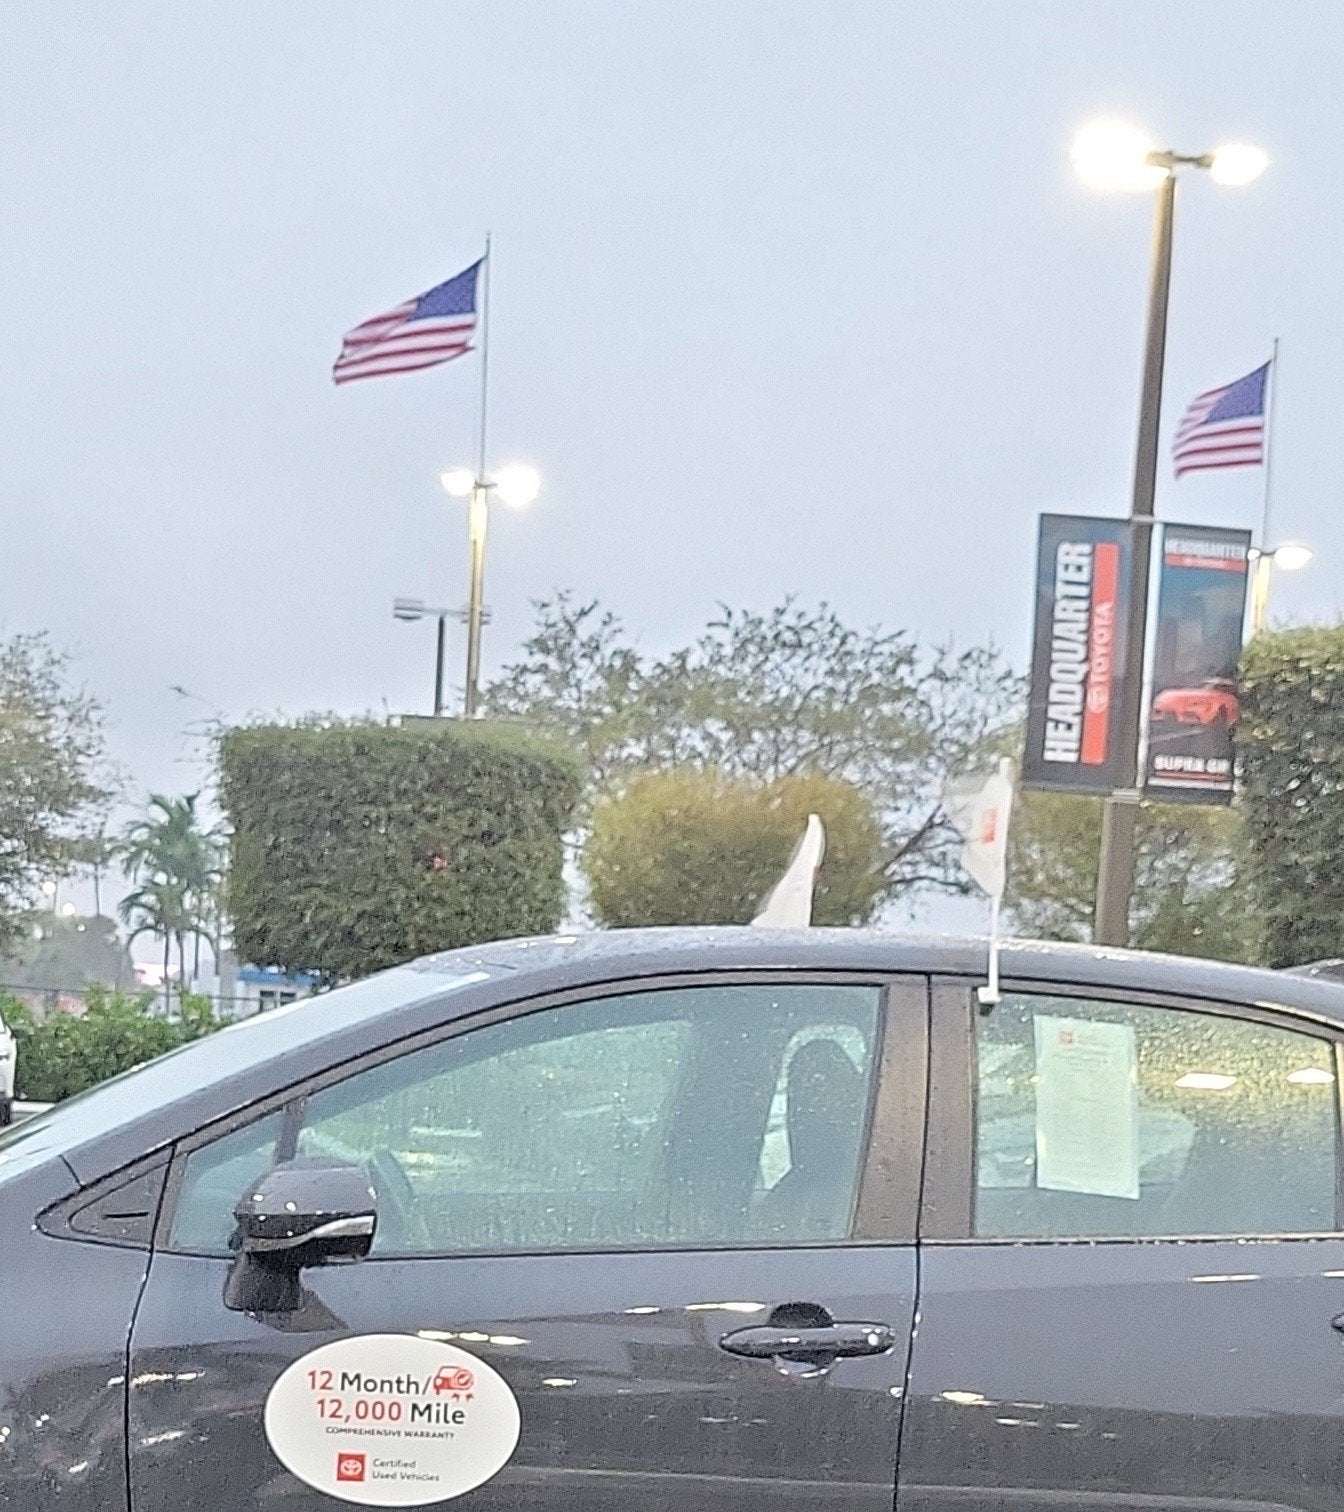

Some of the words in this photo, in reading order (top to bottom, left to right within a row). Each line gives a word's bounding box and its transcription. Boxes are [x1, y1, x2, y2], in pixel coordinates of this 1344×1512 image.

[1043, 542, 1091, 763] HEADQUARTER
[1091, 602, 1114, 683] TOYOTA
[308, 1370, 333, 1390] 12
[340, 1372, 432, 1395] Month/
[317, 1398, 401, 1423] 12,000
[410, 1402, 465, 1425] Mile
[325, 1426, 401, 1437] COMPREHENSIVE
[404, 1430, 455, 1439] WARRANTY
[373, 1458, 417, 1468] Certified
[372, 1471, 397, 1479] Used
[400, 1472, 439, 1481] Vehicles
